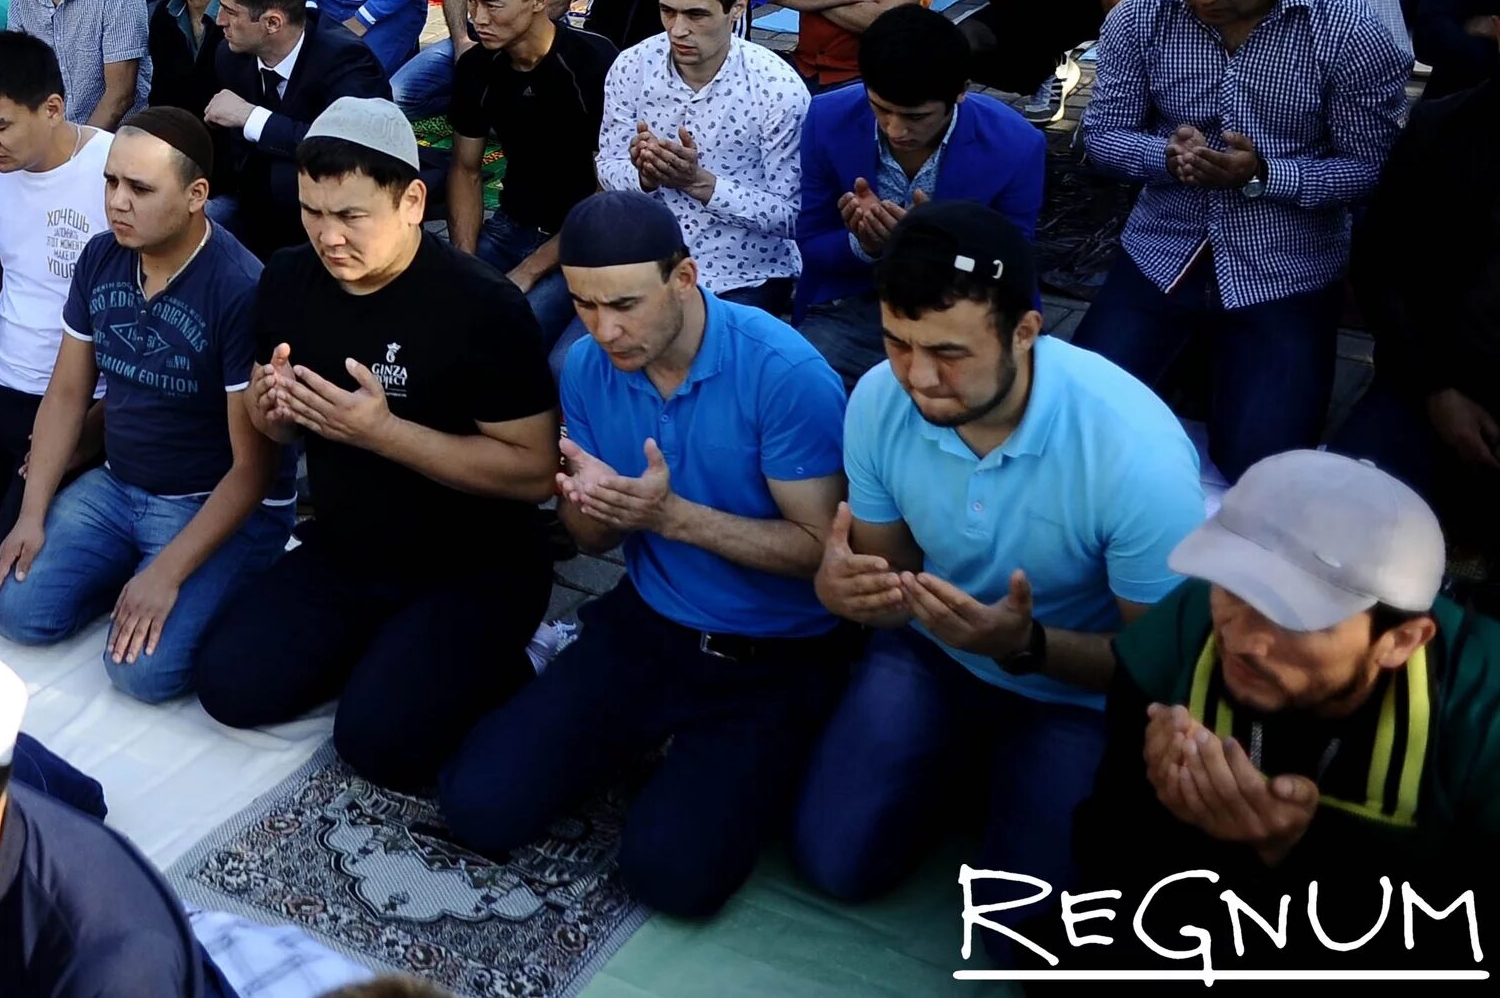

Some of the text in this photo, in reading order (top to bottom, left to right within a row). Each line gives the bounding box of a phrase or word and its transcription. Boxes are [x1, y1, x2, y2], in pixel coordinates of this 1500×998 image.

[47, 208, 90, 234] ХОЧЕШЬ
[47, 256, 77, 279] YOUR
[151, 302, 209, 353] ORIGINALS
[96, 352, 198, 393] EMIUM EDITION
[371, 363, 408, 380] GINZA
